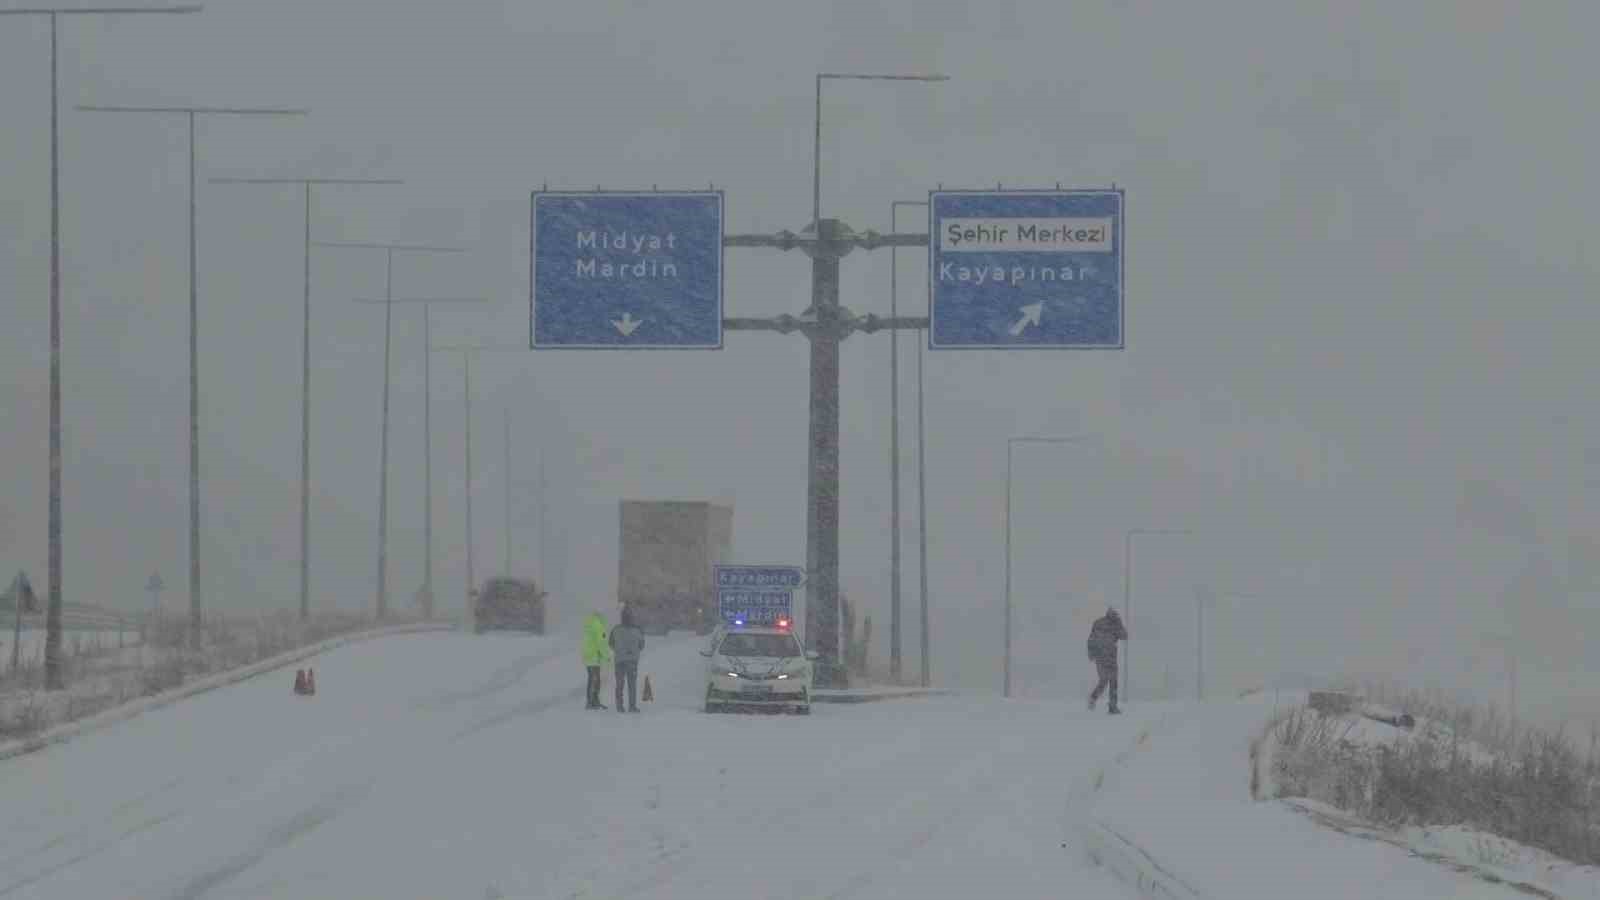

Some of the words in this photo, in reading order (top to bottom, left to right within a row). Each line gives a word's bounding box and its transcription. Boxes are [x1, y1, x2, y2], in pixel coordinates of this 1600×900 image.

[577, 231, 677, 253] Midyat
[948, 224, 1009, 246] Şehir
[1017, 224, 1106, 243] Merkezi
[576, 258, 678, 278] Mardin
[940, 262, 1089, 287] Kayapınar
